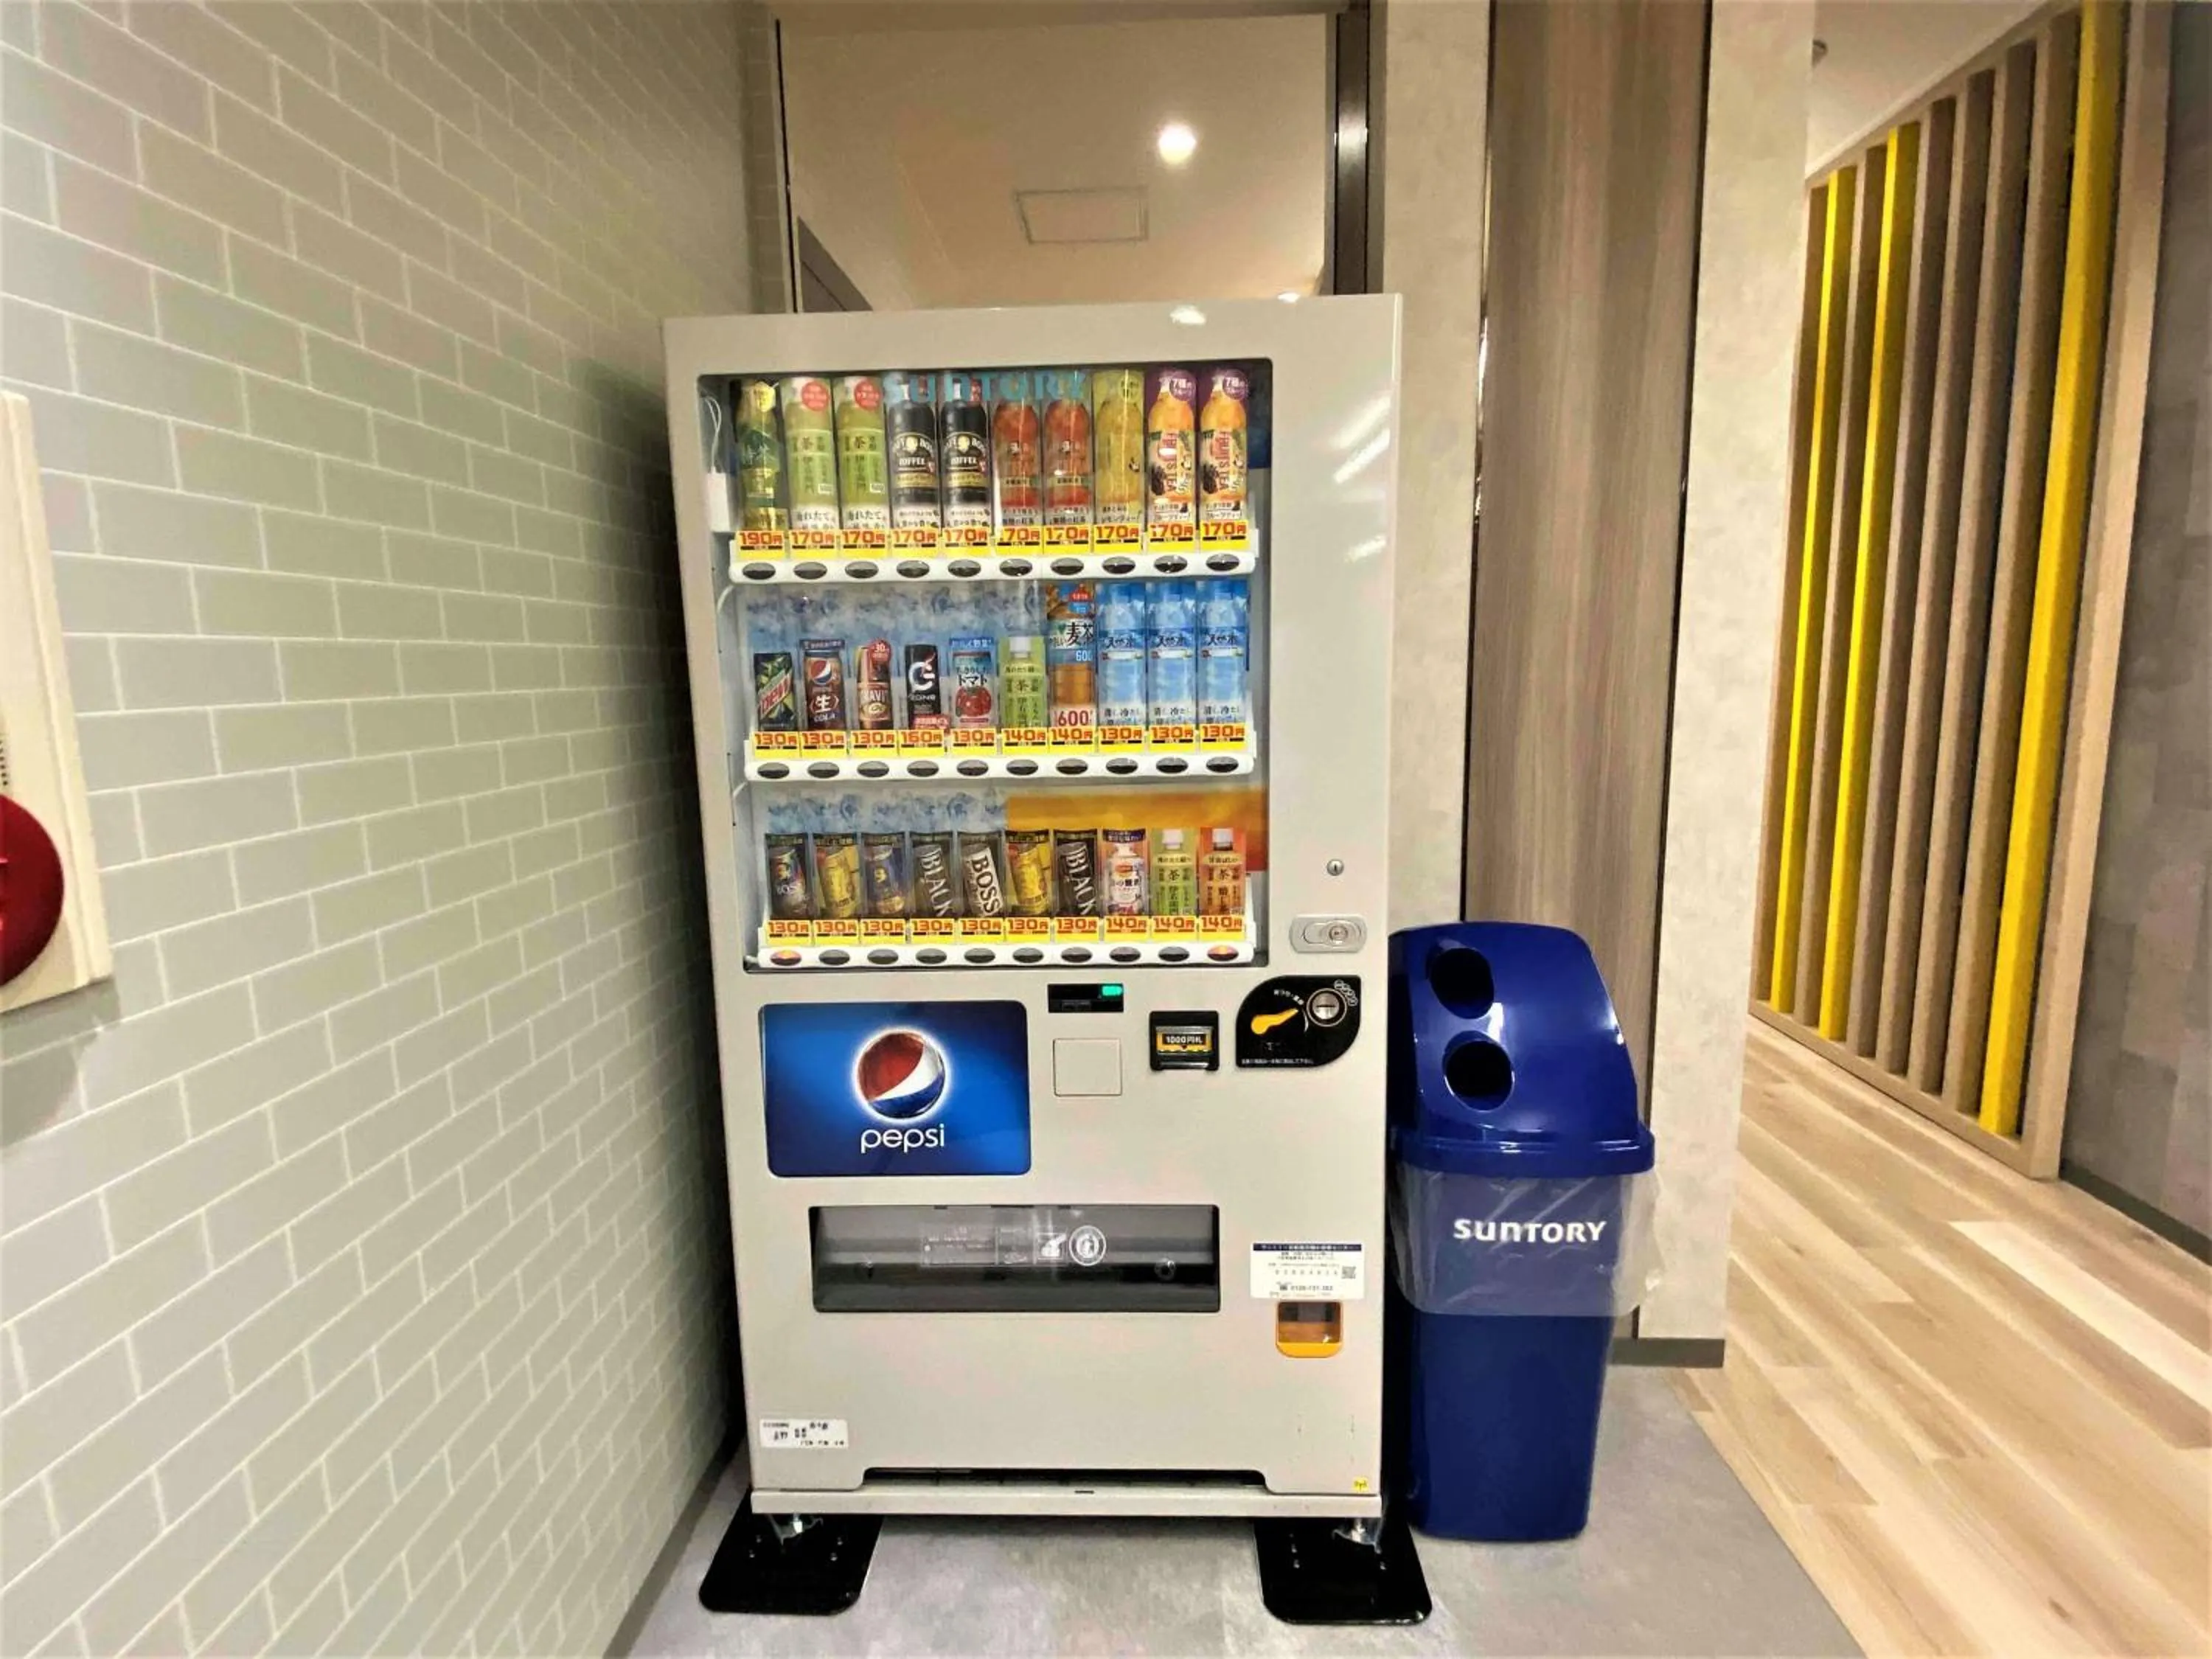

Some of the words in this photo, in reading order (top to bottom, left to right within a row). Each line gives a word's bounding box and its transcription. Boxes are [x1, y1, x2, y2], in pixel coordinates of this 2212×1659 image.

[959, 674, 987, 686] トマト
[815, 694, 832, 714] 生
[921, 849, 953, 917] BLACK
[972, 855, 1001, 914] BOSS
[1065, 846, 1096, 915] BLACK
[860, 1123, 945, 1154] pepsi
[1453, 1218, 1607, 1243] SUNTORY
